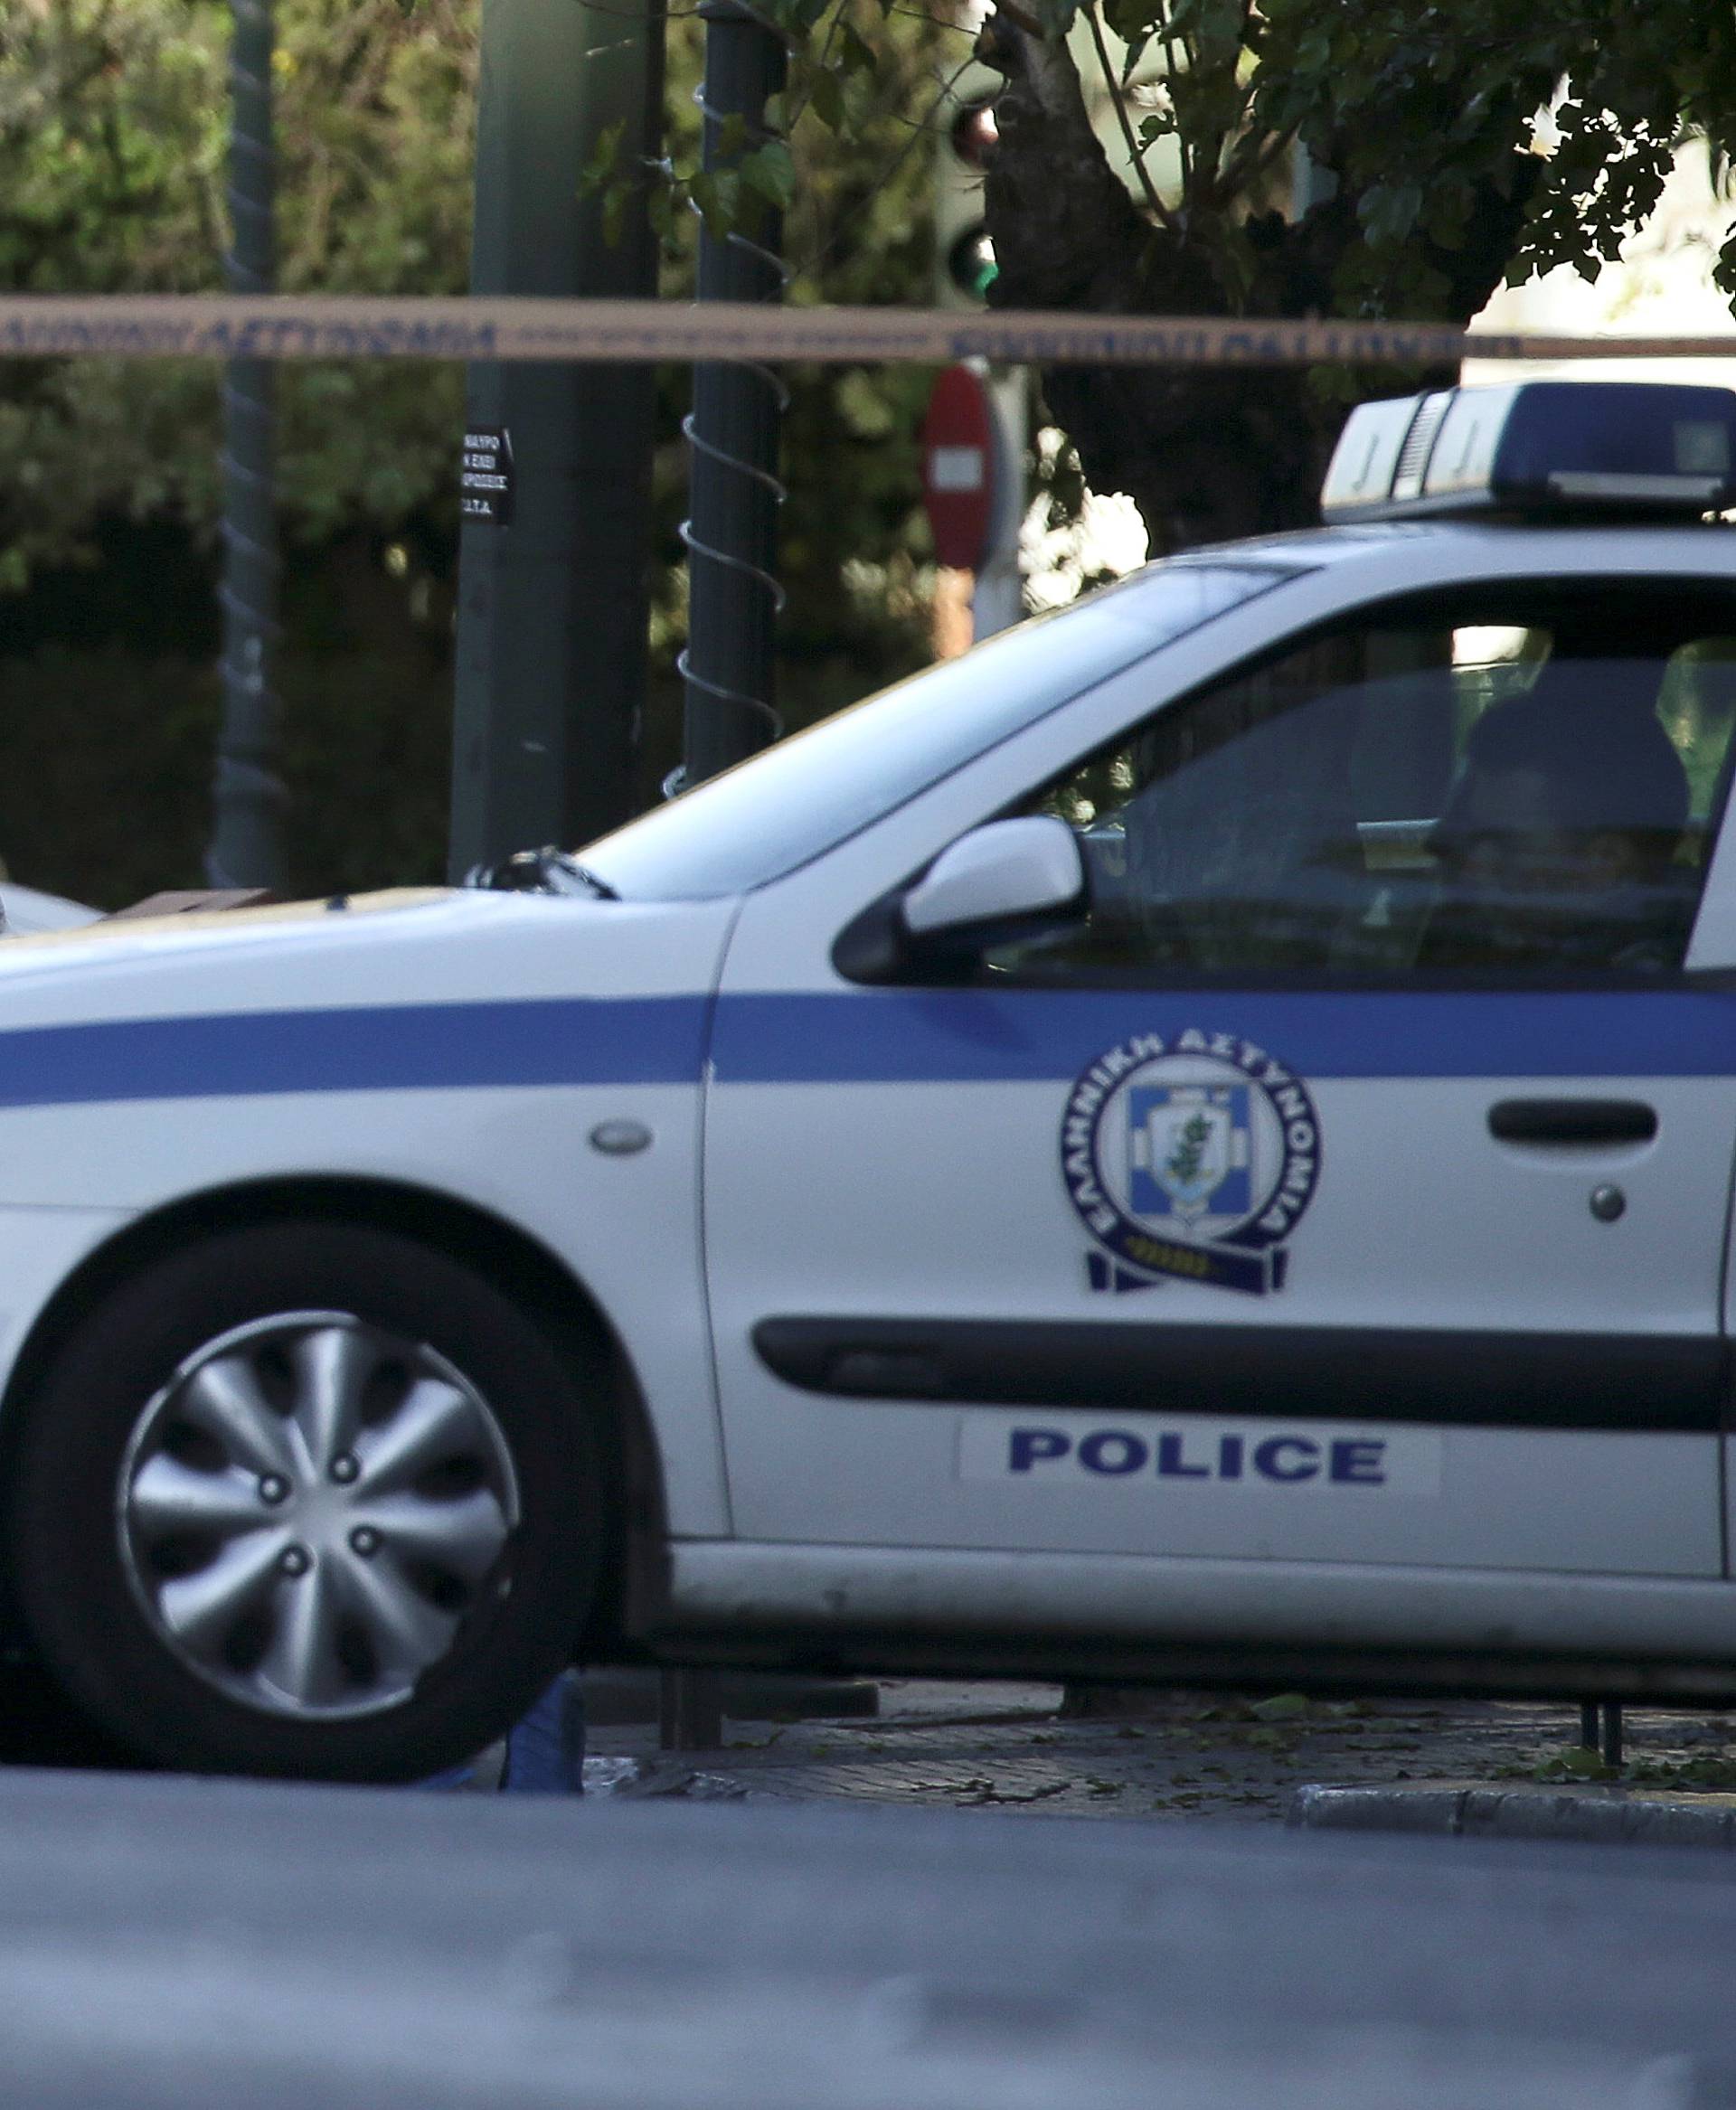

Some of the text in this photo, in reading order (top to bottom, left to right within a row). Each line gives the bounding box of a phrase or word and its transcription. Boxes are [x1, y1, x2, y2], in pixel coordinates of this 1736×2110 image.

[1064, 1028, 1316, 1234] ΕΛΛΗΝΙΚΗ ΑΣΤΥΝΟΜΙΑ
[1008, 1427, 1387, 1484] POLICE
